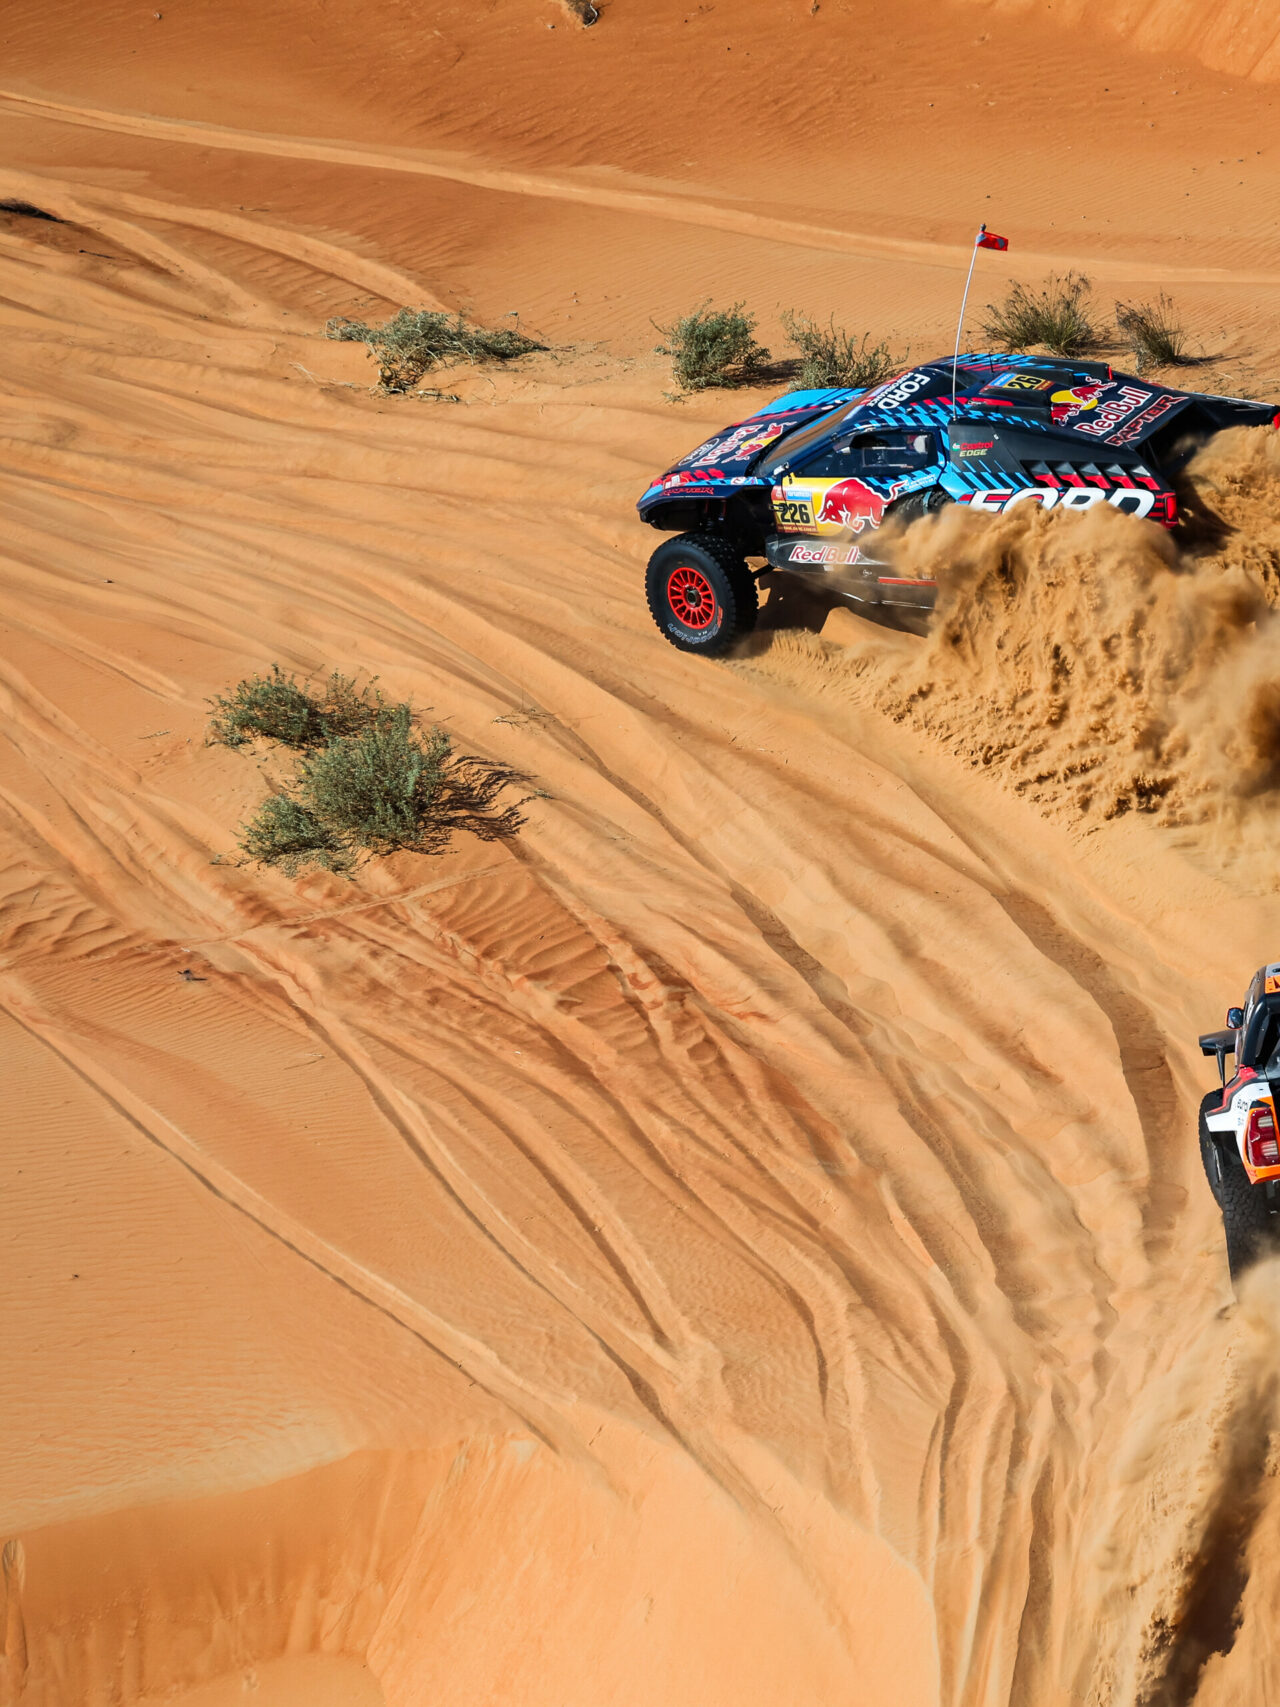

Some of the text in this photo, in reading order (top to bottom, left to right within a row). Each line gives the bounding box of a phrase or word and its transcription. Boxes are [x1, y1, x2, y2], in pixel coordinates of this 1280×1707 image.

[878, 373, 931, 409] FORD
[1104, 395, 1190, 446] RAPTOR
[959, 448, 988, 458] EDGE
[960, 441, 994, 451] Castrol
[779, 502, 811, 524] 226
